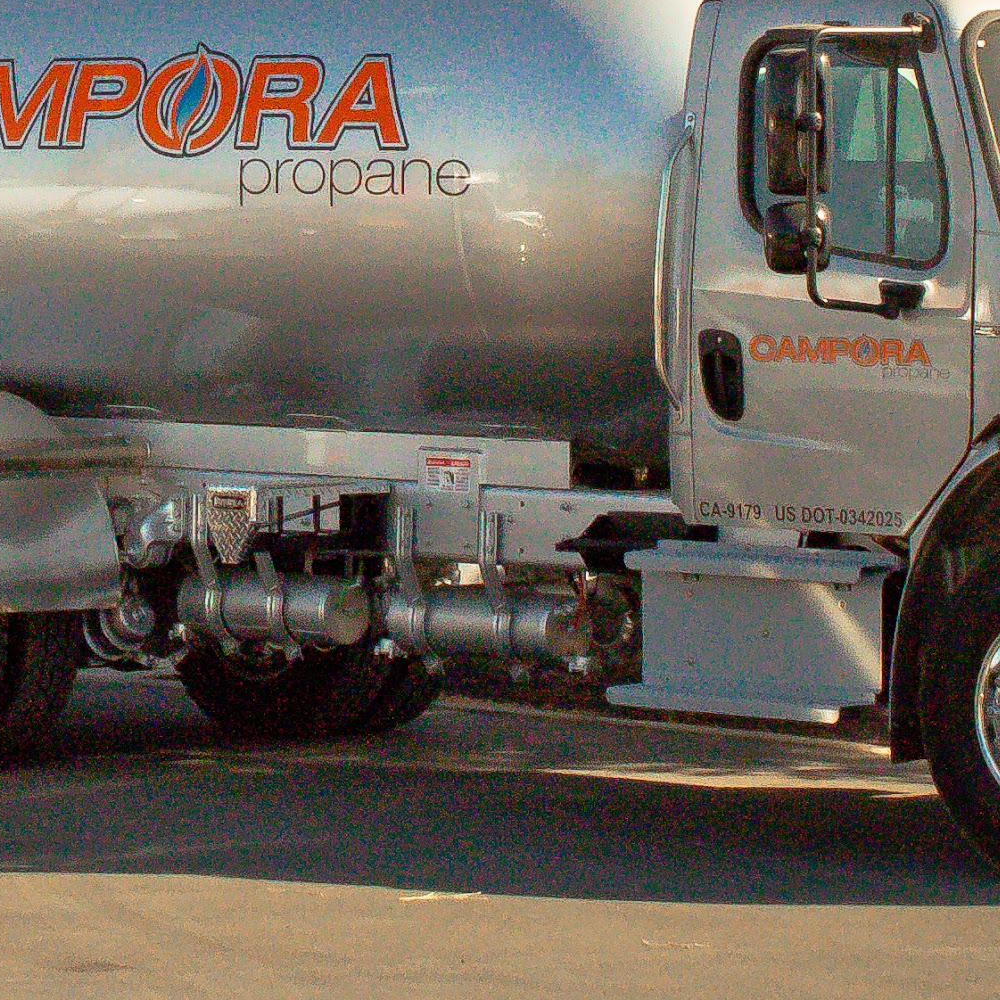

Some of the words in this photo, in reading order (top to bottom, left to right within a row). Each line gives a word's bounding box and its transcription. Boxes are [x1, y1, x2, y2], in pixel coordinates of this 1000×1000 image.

[240, 156, 472, 207] propane
[749, 333, 933, 368] CAMPORA
[699, 501, 763, 521] CA-9179
[774, 505, 797, 523] US
